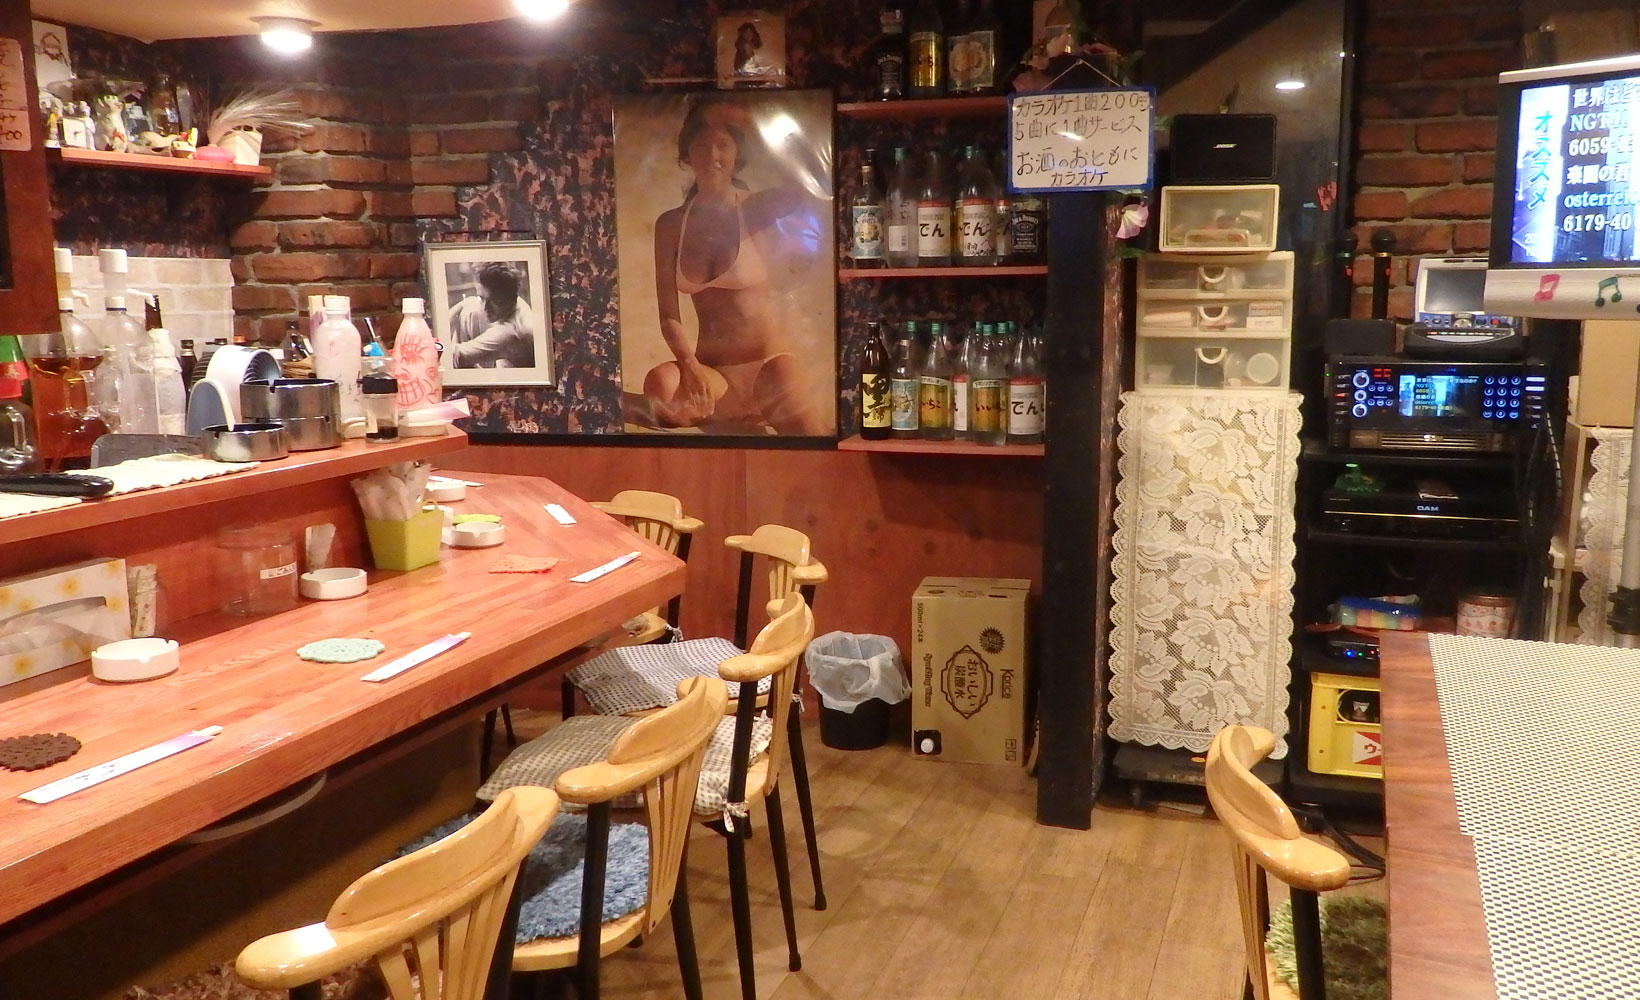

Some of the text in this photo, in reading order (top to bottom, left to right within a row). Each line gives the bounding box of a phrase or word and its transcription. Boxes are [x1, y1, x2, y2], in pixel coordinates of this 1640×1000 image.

[1016, 146, 1138, 175] お酒のおともに
[1527, 110, 1553, 210] オススメ
[1050, 169, 1108, 186] カラオケ
[1563, 211, 1632, 233] 6179-40
[923, 653, 933, 708] Sparkling Water
[954, 665, 966, 699] 炭酸水
[967, 658, 979, 707] おいしい
[1000, 668, 1014, 699] Korice
